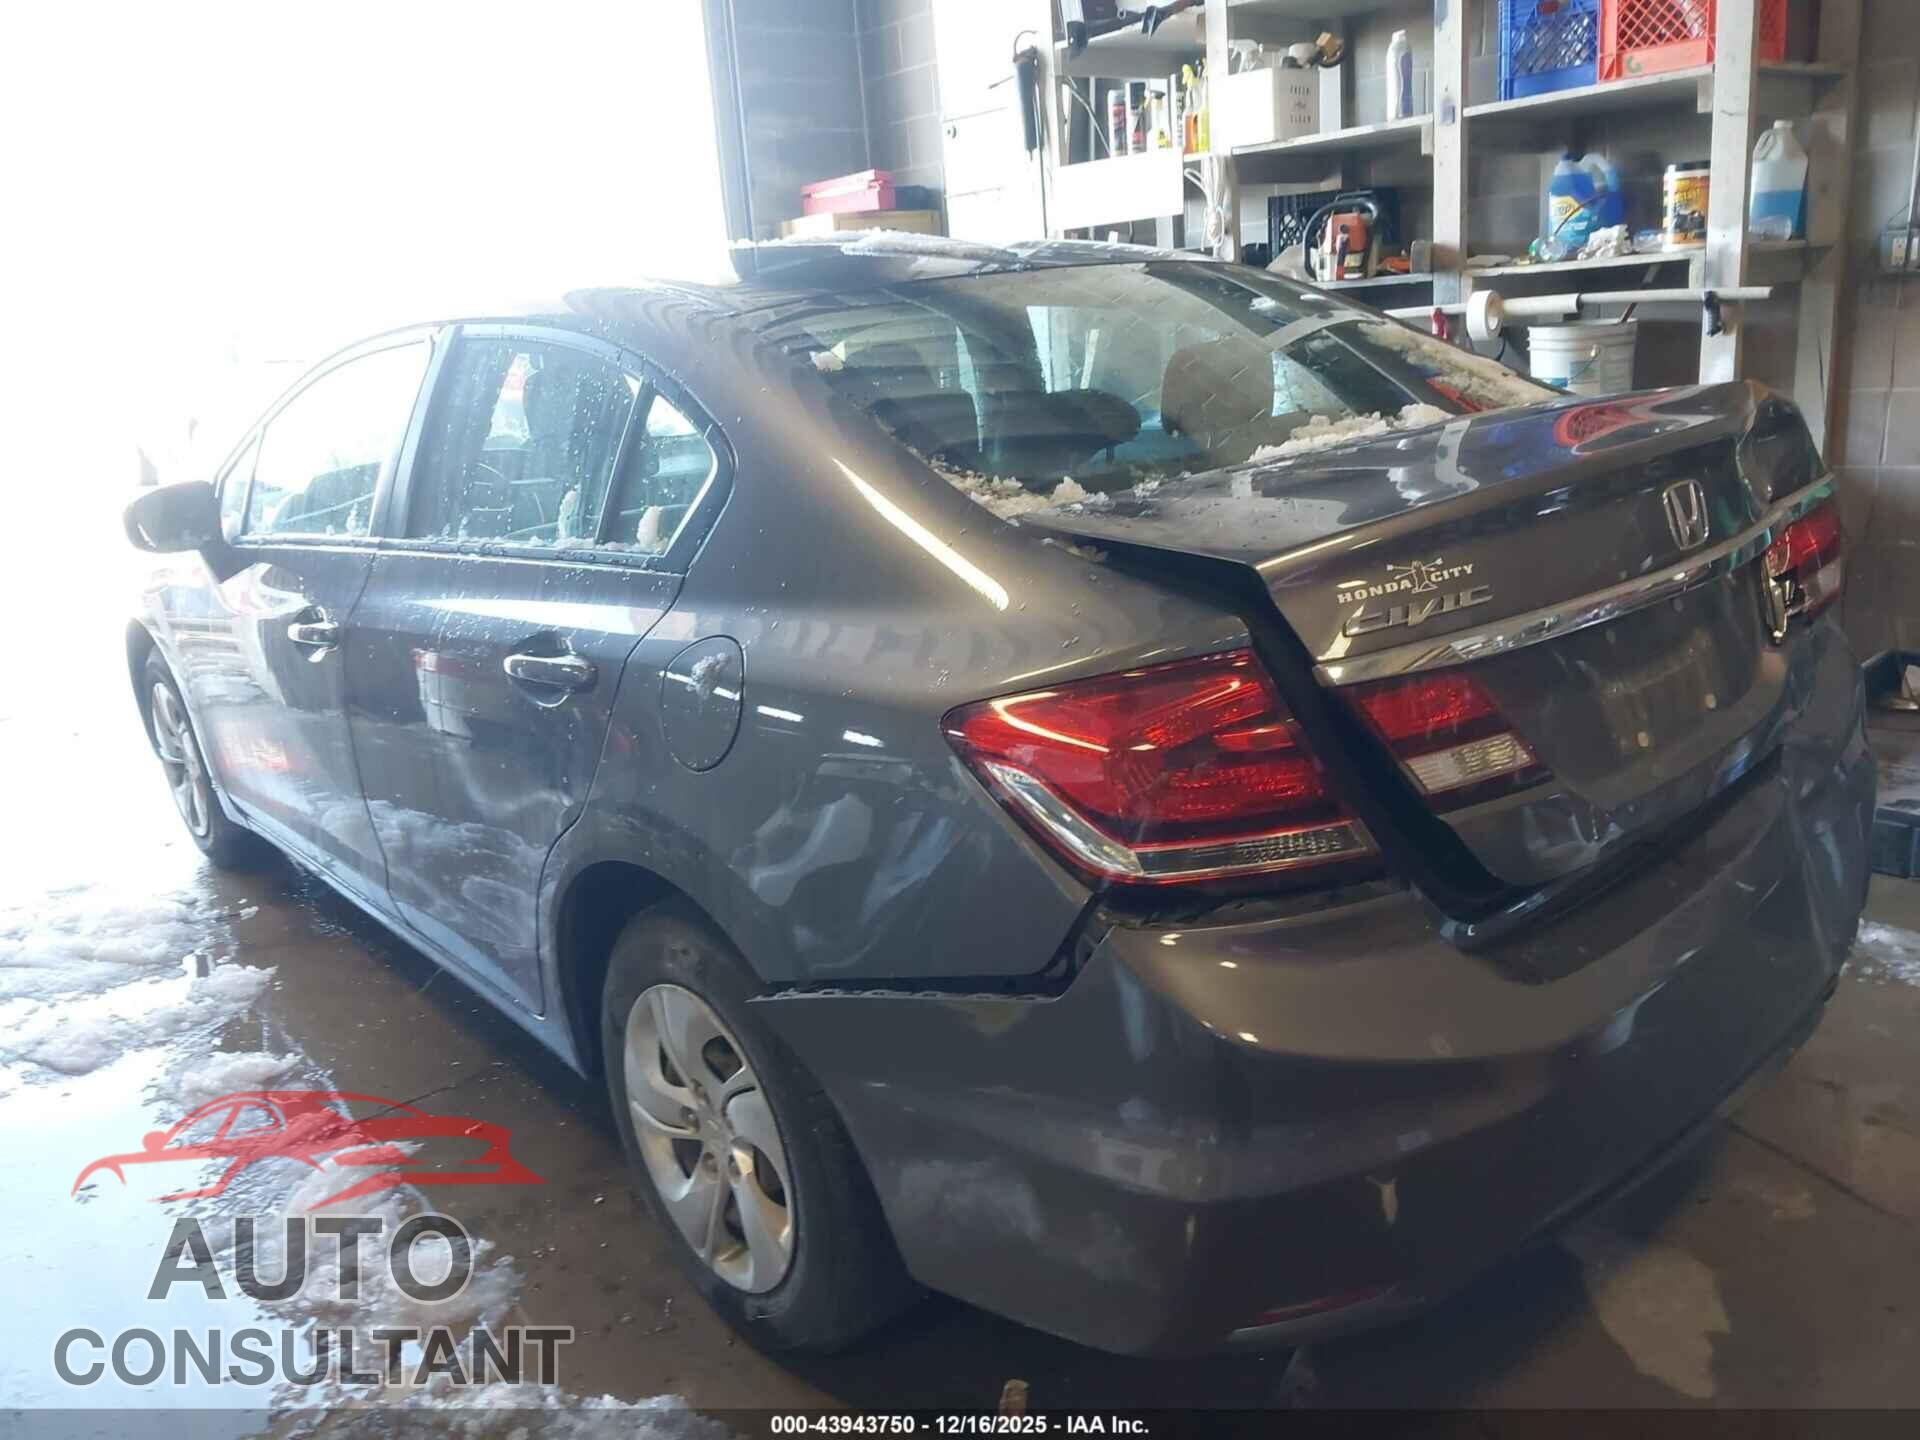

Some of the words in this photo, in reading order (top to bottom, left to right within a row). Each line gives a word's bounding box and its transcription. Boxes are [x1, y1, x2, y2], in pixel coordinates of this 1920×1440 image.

[1337, 579, 1412, 604] HONDA
[1430, 564, 1473, 583] CITY
[1343, 584, 1493, 637] CIVIC
